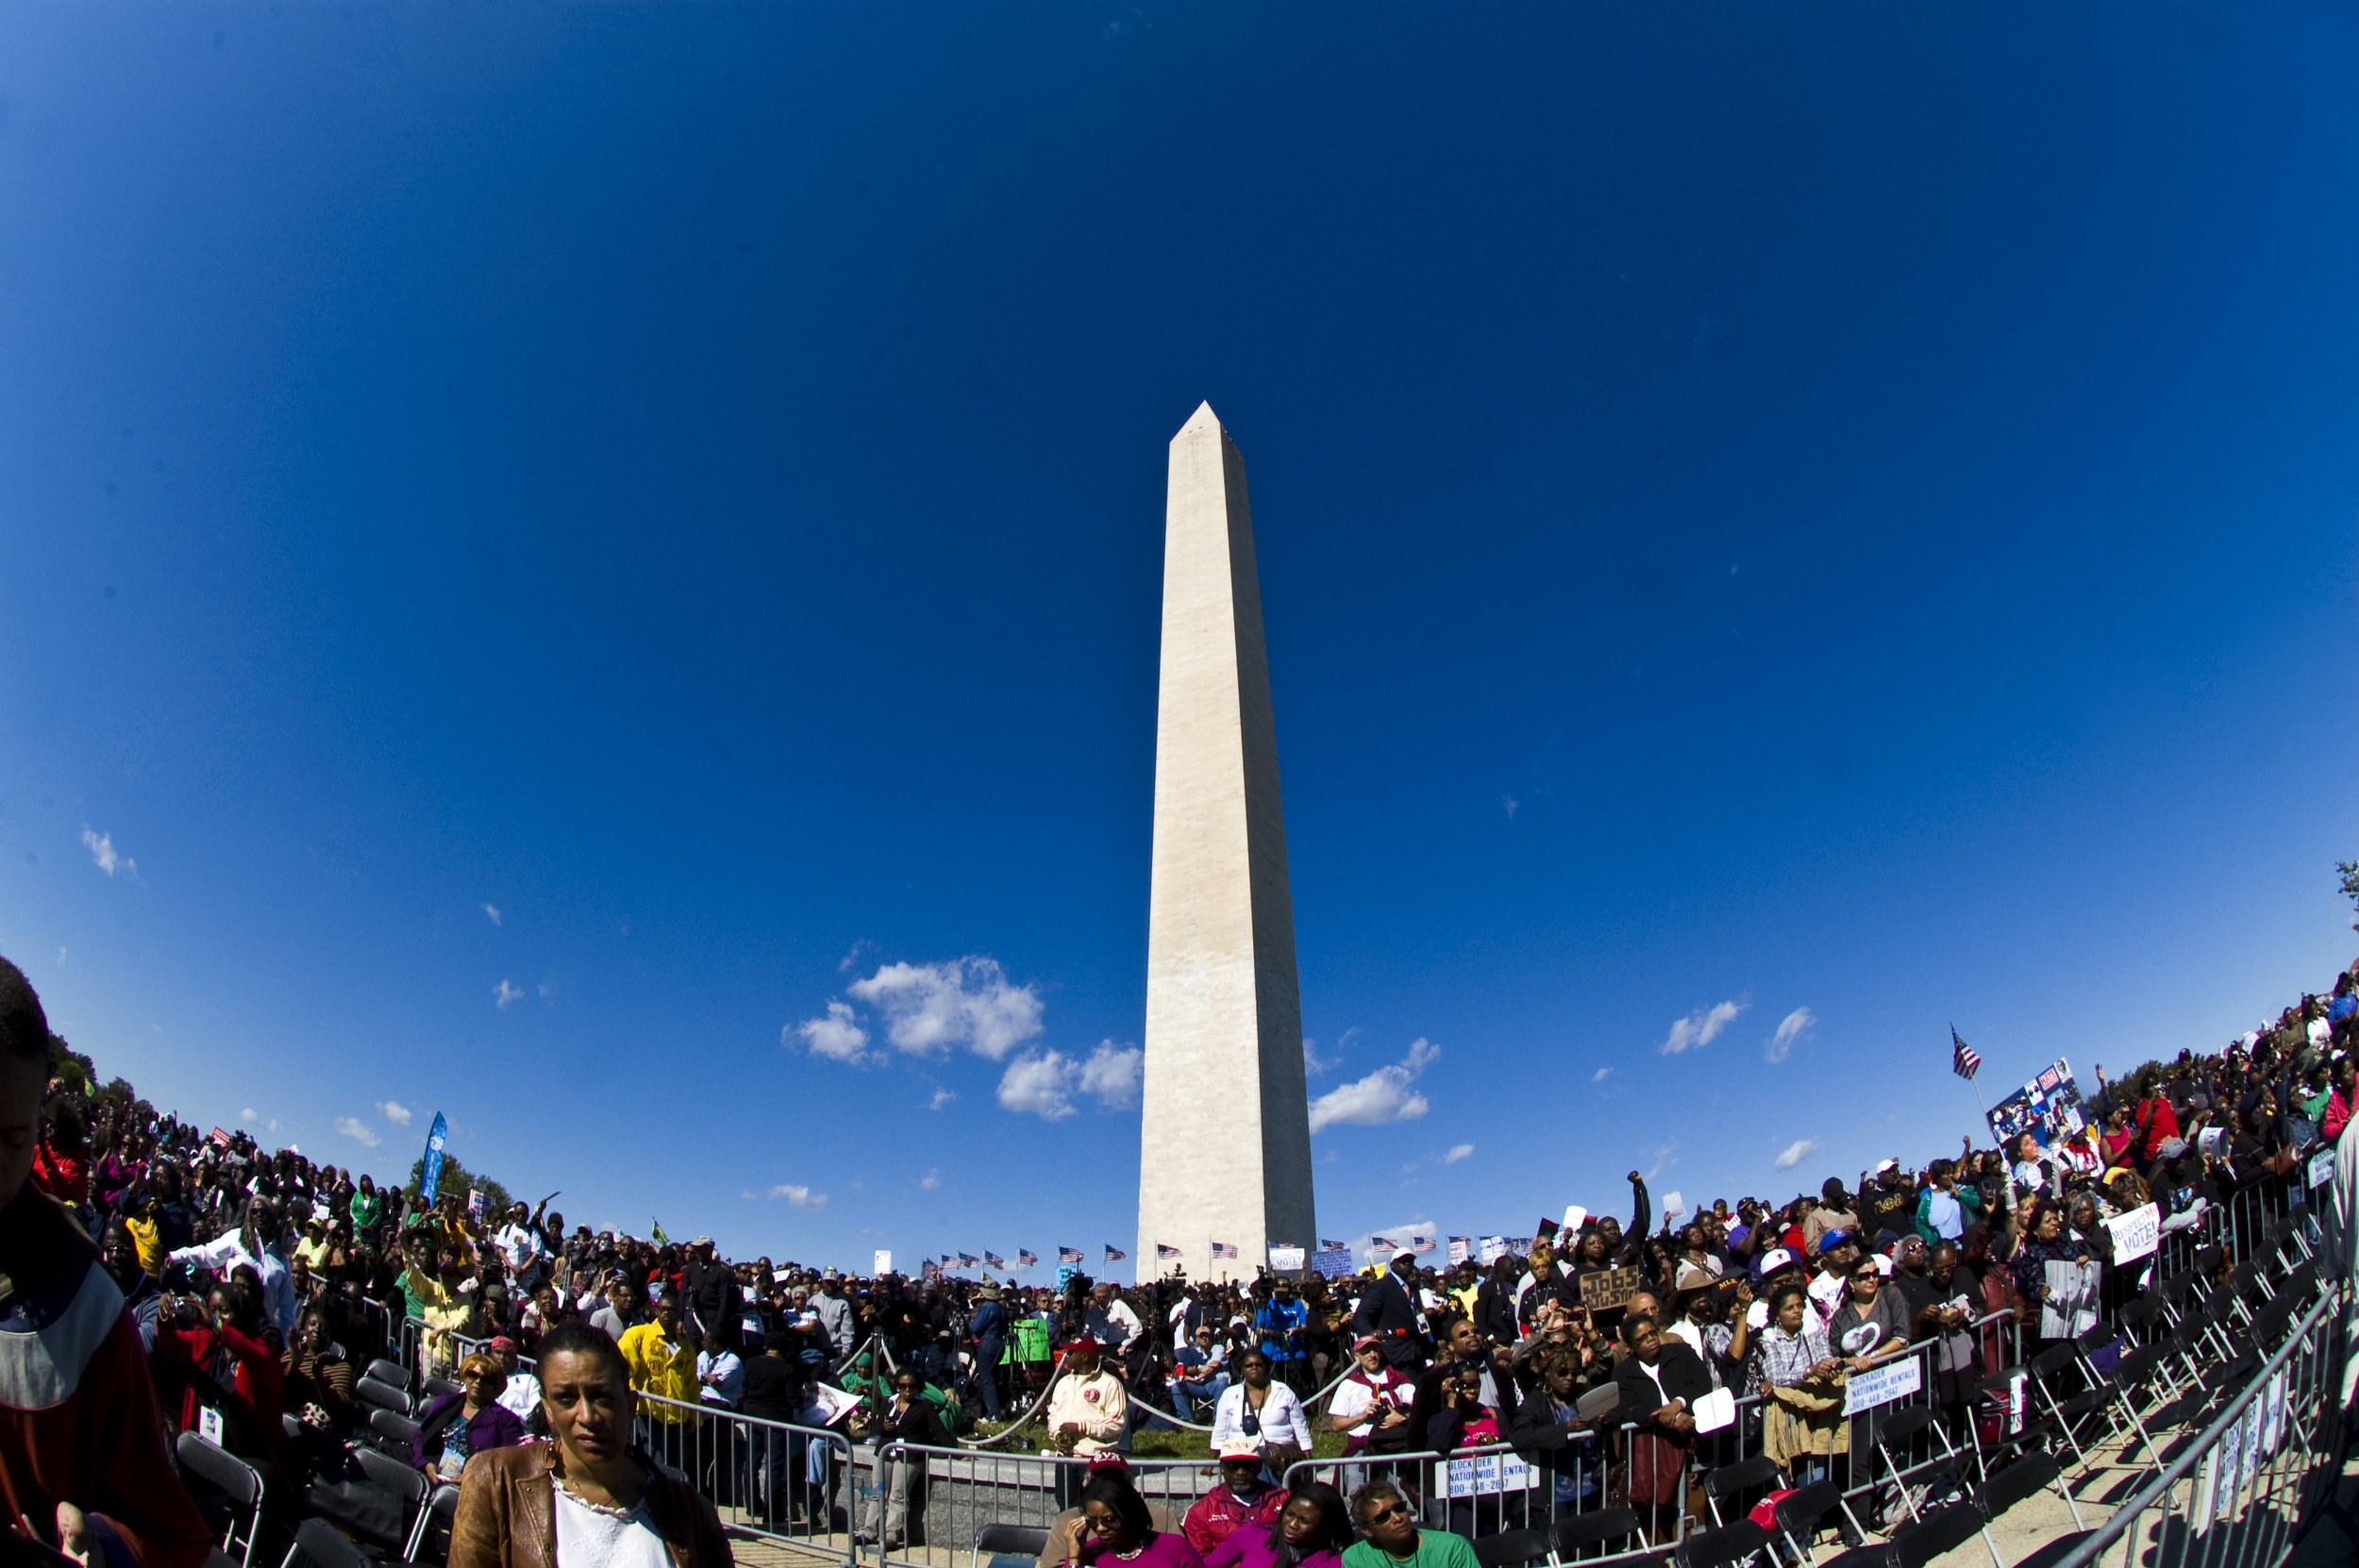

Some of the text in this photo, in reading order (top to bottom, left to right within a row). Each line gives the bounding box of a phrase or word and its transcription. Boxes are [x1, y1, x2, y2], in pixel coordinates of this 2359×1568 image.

[2123, 1220, 2155, 1254] VOTE!
[1718, 1278, 1737, 1290] MLK
[1851, 1369, 1915, 1398] NATIONWIDE RENTALS
[1449, 1457, 1492, 1471] BLOCKDER
[1503, 1464, 1532, 1476] ENTALS
